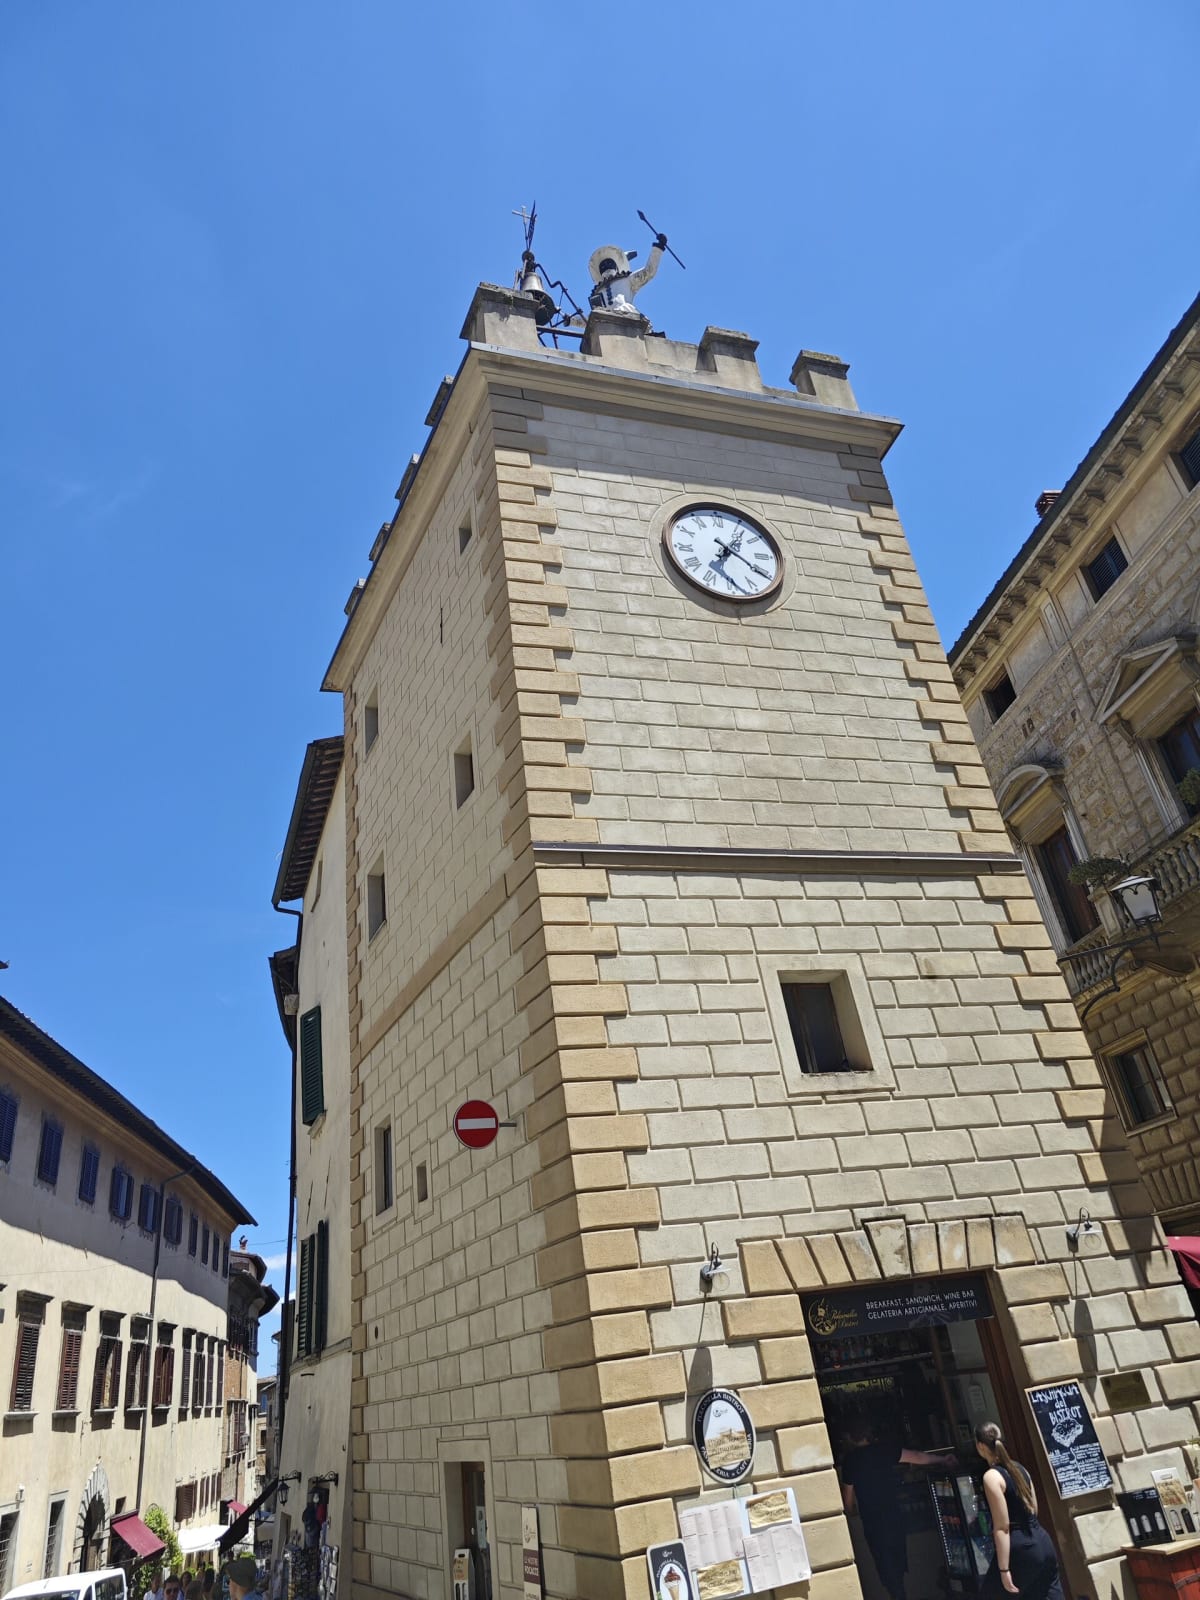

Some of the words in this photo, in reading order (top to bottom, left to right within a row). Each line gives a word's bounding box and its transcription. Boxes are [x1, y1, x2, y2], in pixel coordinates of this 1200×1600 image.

[866, 1299, 904, 1310] BREAKFAST,
[905, 1295, 942, 1305] SANDWICH,
[943, 1291, 961, 1301] WINE
[962, 1289, 975, 1298] BAR
[867, 1309, 903, 1320] GELATERIA
[904, 1304, 947, 1317] ARTIGIANALE,
[948, 1299, 978, 1310] APERITIVI
[722, 1393, 745, 1414] BISTROT
[1049, 1406, 1082, 1425] BISTROT
